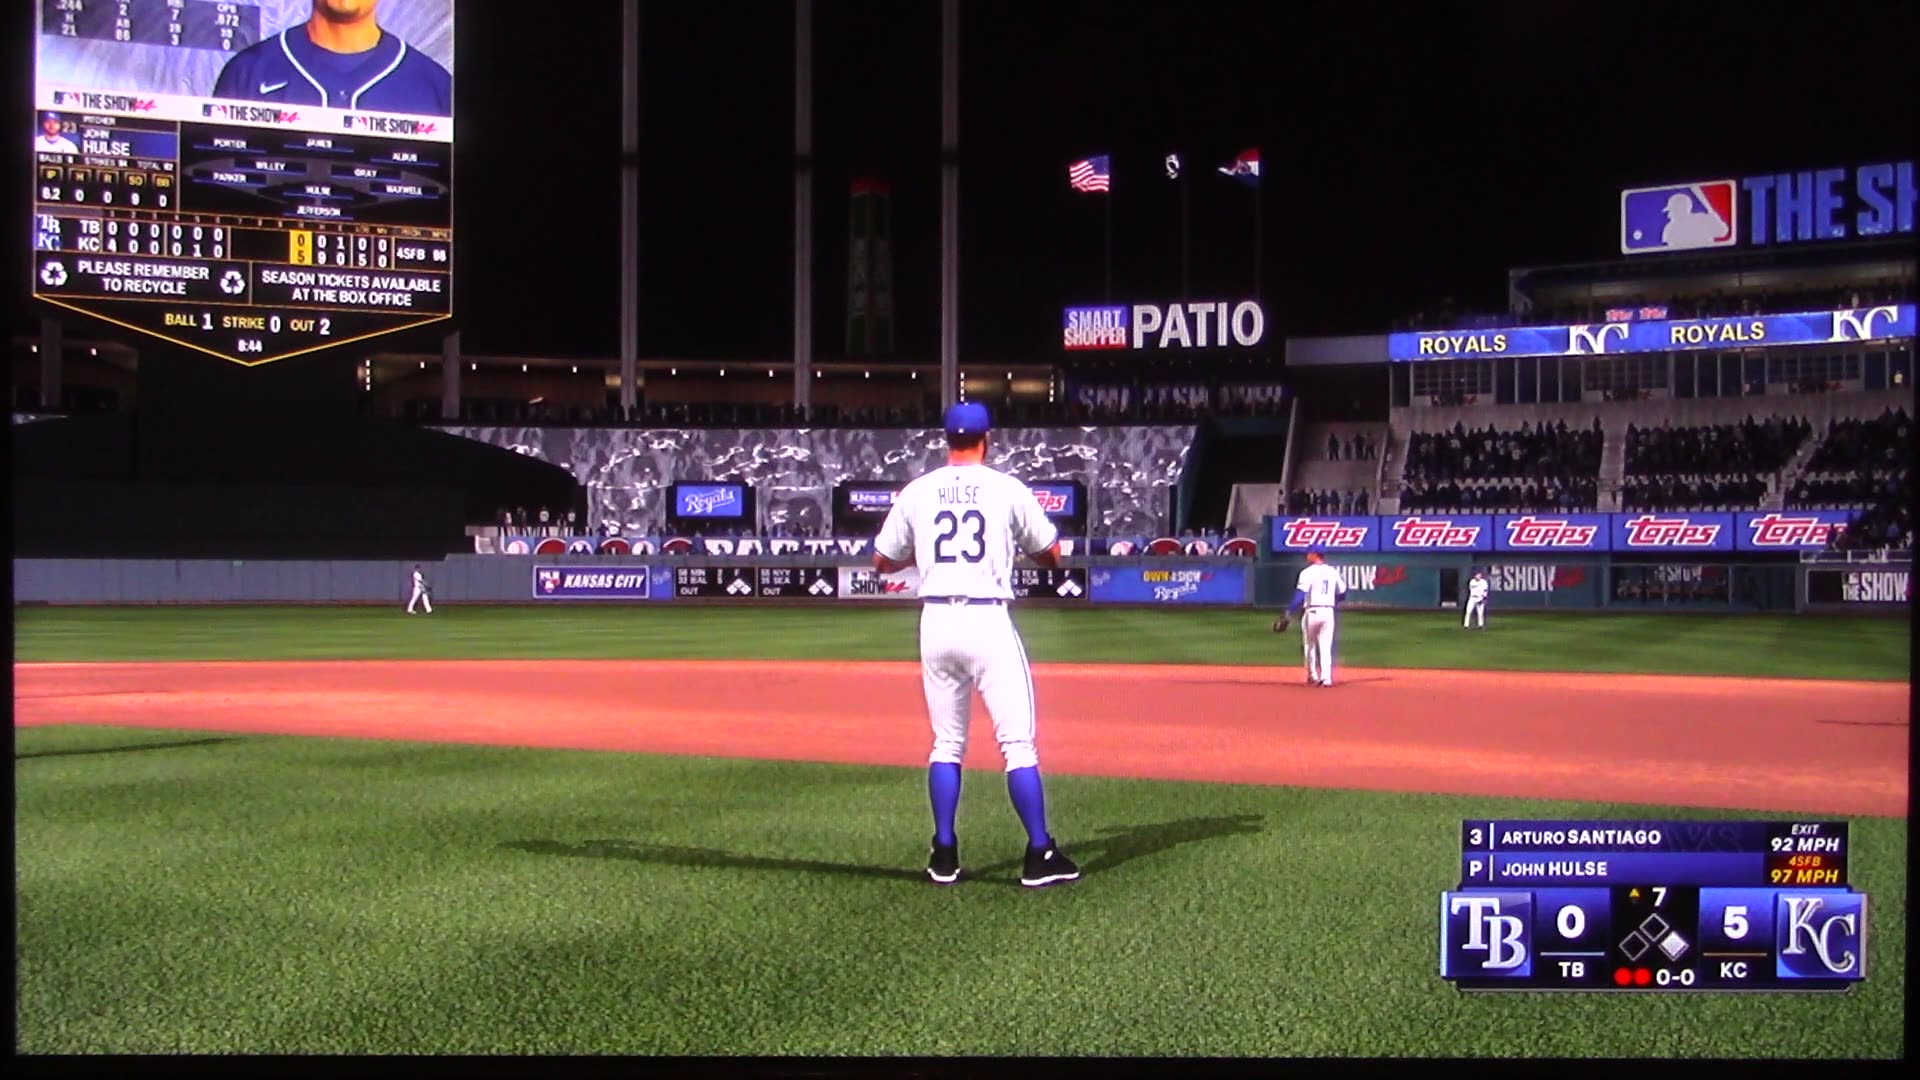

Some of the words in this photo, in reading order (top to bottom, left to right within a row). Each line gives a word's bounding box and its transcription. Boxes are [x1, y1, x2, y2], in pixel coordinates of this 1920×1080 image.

[82, 93, 102, 108] THE
[104, 95, 137, 111] SHOW
[229, 105, 248, 120] THE
[250, 108, 280, 124] SHOW
[84, 128, 110, 139] JOHN
[370, 116, 387, 132] THE
[388, 119, 419, 135] SHOW
[83, 140, 130, 156] HULSE
[76, 190, 84, 202] 0
[104, 192, 112, 204] 0
[159, 195, 168, 207] 0
[1743, 168, 1845, 244] THE
[80, 220, 100, 234] TB
[108, 222, 117, 235] 0
[130, 223, 139, 236] 0
[151, 224, 160, 238] 0
[172, 226, 182, 239] 0
[194, 227, 202, 240] 0
[214, 228, 222, 242] 0
[298, 234, 305, 246] 0
[318, 236, 326, 248] 0
[337, 236, 344, 250] 1
[358, 238, 366, 250] 0
[378, 239, 387, 252] 0
[78, 237, 100, 252] KC
[108, 238, 117, 252] 4
[130, 240, 138, 254] 0
[151, 242, 160, 254] 0
[172, 242, 182, 256] 0
[194, 244, 202, 257] 1
[214, 246, 222, 258] 0
[298, 250, 305, 263] 5
[318, 252, 326, 264] 9
[336, 253, 345, 266] 0
[358, 254, 367, 266] 5
[378, 255, 387, 268] 0
[78, 260, 131, 276] PLEASE
[134, 264, 210, 280] REMEMBER
[102, 278, 122, 292] TO
[124, 279, 187, 295] RECYCLE
[262, 270, 314, 286] SEASON
[318, 273, 370, 288] TICKETS
[372, 276, 441, 292] AVAILABLE
[292, 288, 310, 301] AT
[313, 289, 338, 302] THE
[340, 290, 366, 304] BOX
[369, 292, 412, 306] OFFICE
[165, 313, 197, 326] BALL
[202, 313, 213, 330] 1
[223, 316, 266, 330] STRIKE
[270, 316, 280, 333] 0
[290, 319, 315, 332] OUT
[320, 318, 330, 335] 2
[1068, 310, 1121, 328] SMART
[1133, 300, 1264, 348] PATIO
[1064, 327, 1126, 346] SHOPPER
[1419, 334, 1506, 355] ROYALS
[1671, 321, 1765, 344] ROYALS
[685, 488, 735, 513] Royals
[938, 486, 980, 504] HULSE
[934, 510, 986, 564] 23
[564, 574, 614, 588] KANSAS
[614, 574, 645, 588] CITY
[851, 580, 888, 594] SHOW
[1503, 566, 1556, 592] SHOW
[1842, 584, 1860, 601] THE
[1861, 572, 1908, 602] SHOW
[680, 587, 698, 596] OUT
[763, 587, 780, 596] OUT
[1470, 830, 1482, 844] 3
[1501, 831, 1565, 845] ARTURO
[1568, 830, 1662, 845] SANTIAGO
[1792, 824, 1818, 836] EXIT
[1770, 838, 1794, 852] 92
[1798, 838, 1840, 852] MPH
[1470, 862, 1483, 876] P
[1501, 862, 1545, 876] JOHN
[1548, 862, 1608, 876] HULSE
[1788, 856, 1821, 868] 4SFB
[1770, 870, 1794, 884] 97
[1798, 869, 1840, 884] MPH
[1652, 888, 1666, 907] 7
[1556, 906, 1585, 938] 0
[1723, 906, 1748, 939] 5
[1450, 897, 1527, 969] TB
[1782, 897, 1857, 973] KC
[1559, 962, 1584, 978] TB
[1656, 969, 1695, 986] 0-0
[1720, 962, 1748, 979] KC
